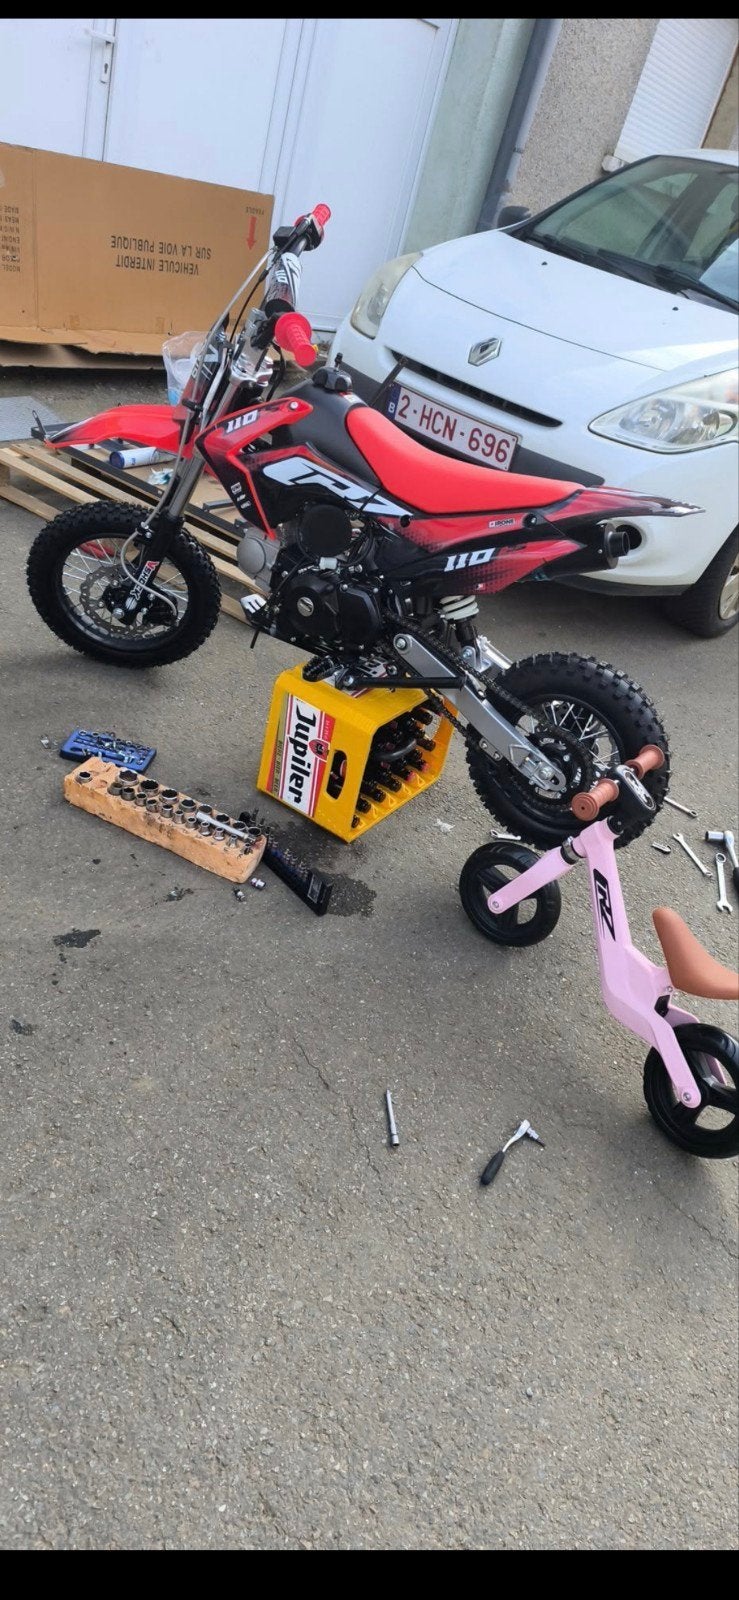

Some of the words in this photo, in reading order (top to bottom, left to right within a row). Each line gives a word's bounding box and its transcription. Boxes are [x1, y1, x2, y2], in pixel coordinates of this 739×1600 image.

[110, 235, 155, 253] PUBLIQUE
[158, 241, 178, 255] VOIE
[181, 244, 192, 257] LA
[195, 246, 212, 260] SUR
[115, 254, 155, 271] INTERDIT
[158, 259, 199, 276] VEHICULE
[387, 401, 396, 414] B
[226, 409, 258, 434] 110
[397, 394, 511, 463] 2-HCN-696
[444, 547, 496, 572] 110
[287, 704, 317, 804] Jupiler
